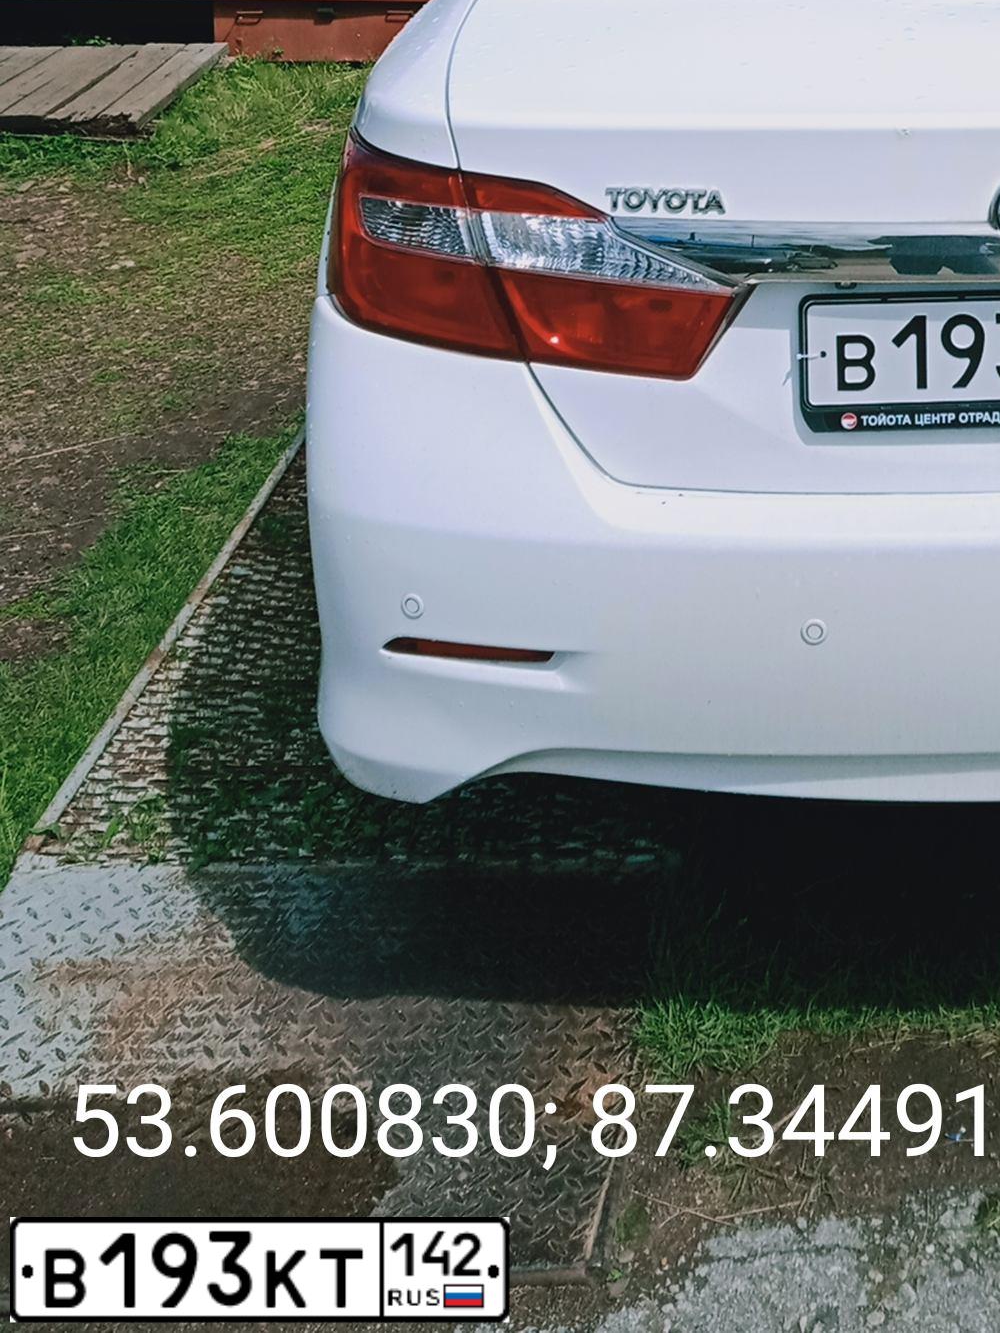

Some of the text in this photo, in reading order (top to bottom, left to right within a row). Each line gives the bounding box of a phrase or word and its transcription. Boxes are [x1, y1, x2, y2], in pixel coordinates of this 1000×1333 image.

[605, 187, 726, 215] TOYOTA
[861, 413, 912, 427] ТОЙОТА
[914, 412, 956, 427] ЦЕНТР
